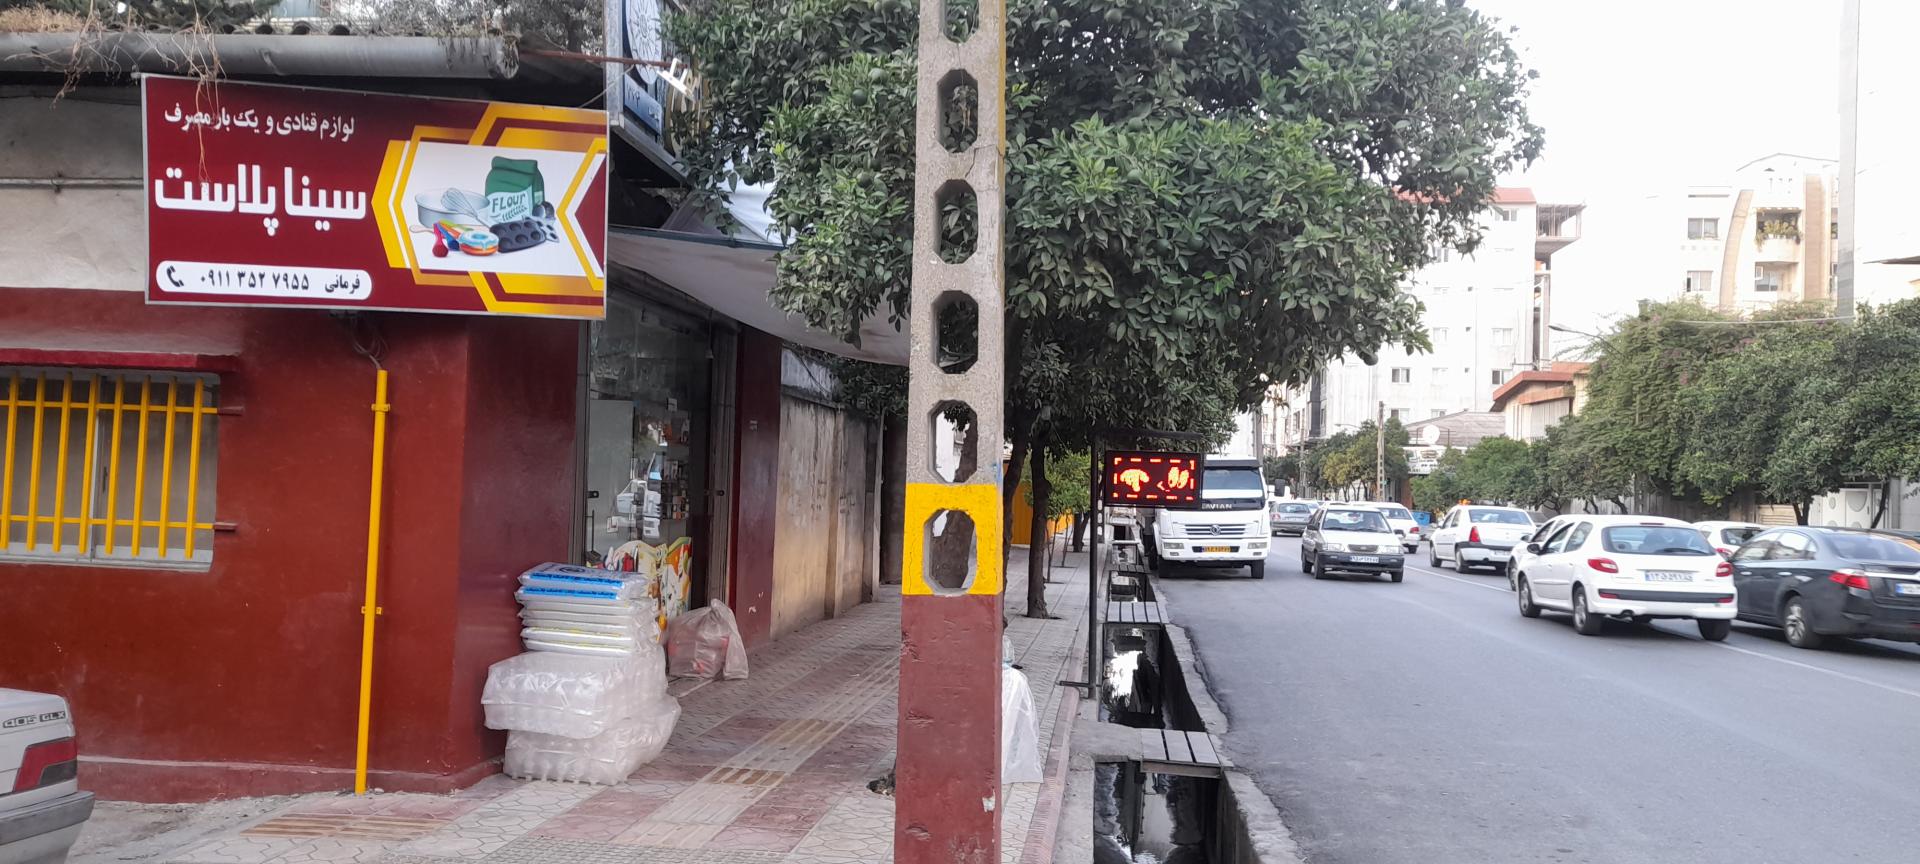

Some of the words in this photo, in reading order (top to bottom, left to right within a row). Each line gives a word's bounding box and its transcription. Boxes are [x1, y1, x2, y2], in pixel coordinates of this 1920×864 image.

[164, 102, 212, 131] مصرف
[214, 107, 231, 132] بار
[265, 115, 274, 135] و
[276, 111, 318, 136] قنادی
[320, 116, 355, 142] لوازم
[155, 163, 280, 237] پلاست
[284, 166, 366, 231] سینا
[200, 269, 231, 288] ۰۹۱۱
[324, 273, 361, 295] فرمانی
[4, 715, 38, 727] 405
[42, 711, 65, 720] GLX
